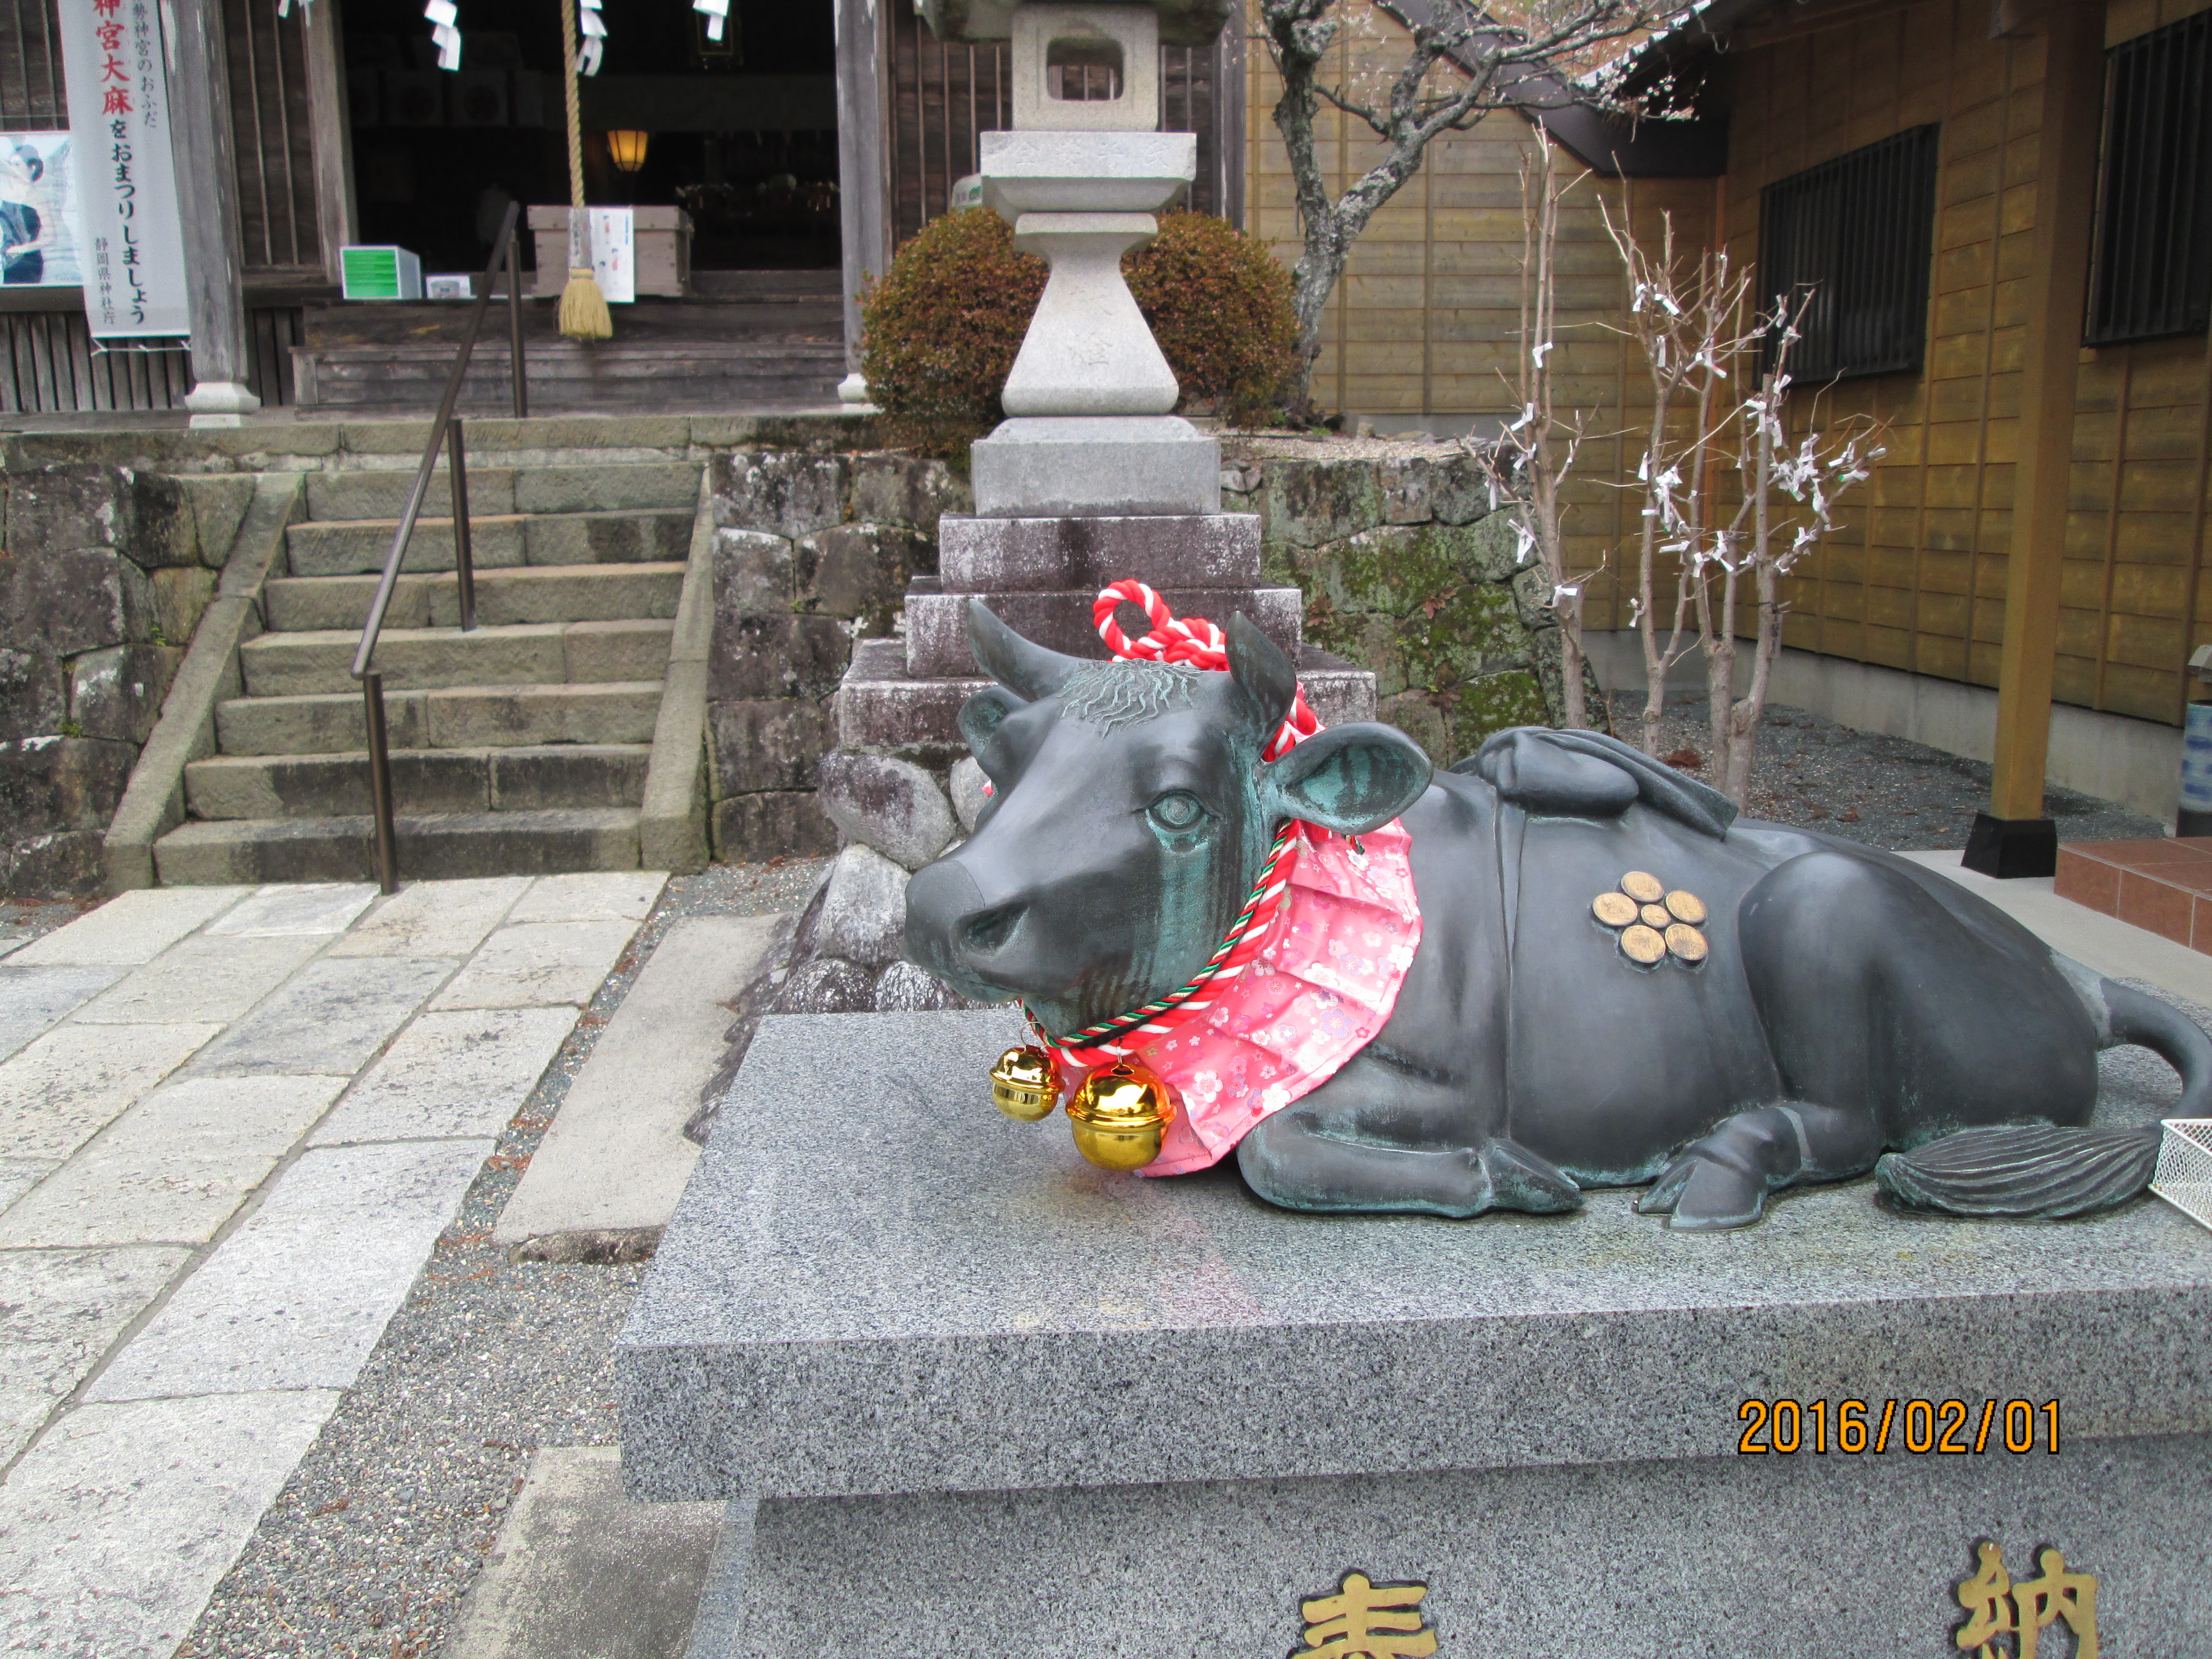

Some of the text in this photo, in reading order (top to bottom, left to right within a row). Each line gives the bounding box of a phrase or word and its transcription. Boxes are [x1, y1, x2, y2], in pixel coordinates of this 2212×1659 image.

[132, 0, 157, 128] 勢神宮のおふだ
[1956, 1540, 2098, 1659] 納
